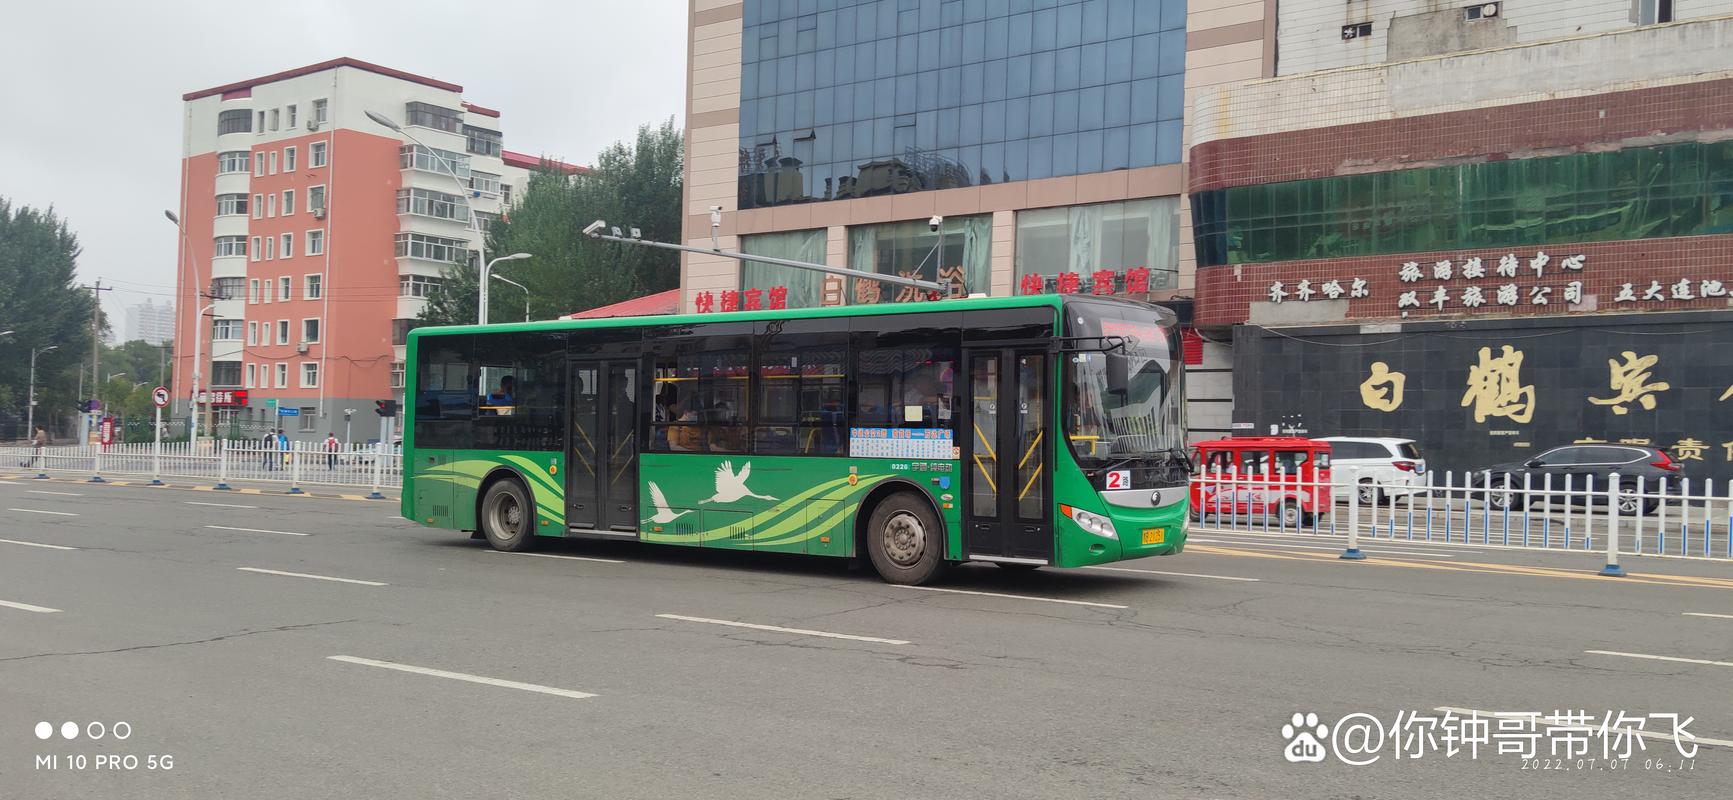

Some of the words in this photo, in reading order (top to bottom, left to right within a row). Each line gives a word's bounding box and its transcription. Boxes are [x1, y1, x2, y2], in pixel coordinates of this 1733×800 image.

[1399, 252, 1586, 282] 旅游接待中心
[1021, 267, 1149, 295] 快捷宾馆
[1268, 278, 1369, 302] 齐齐哈尔
[1614, 278, 1733, 302] 五大连池
[695, 286, 788, 313] 快捷宾馆
[1399, 280, 1584, 310] 双丰旅游公司
[1360, 345, 1733, 424] 白鹤宾
[1108, 472, 1121, 488] 2
